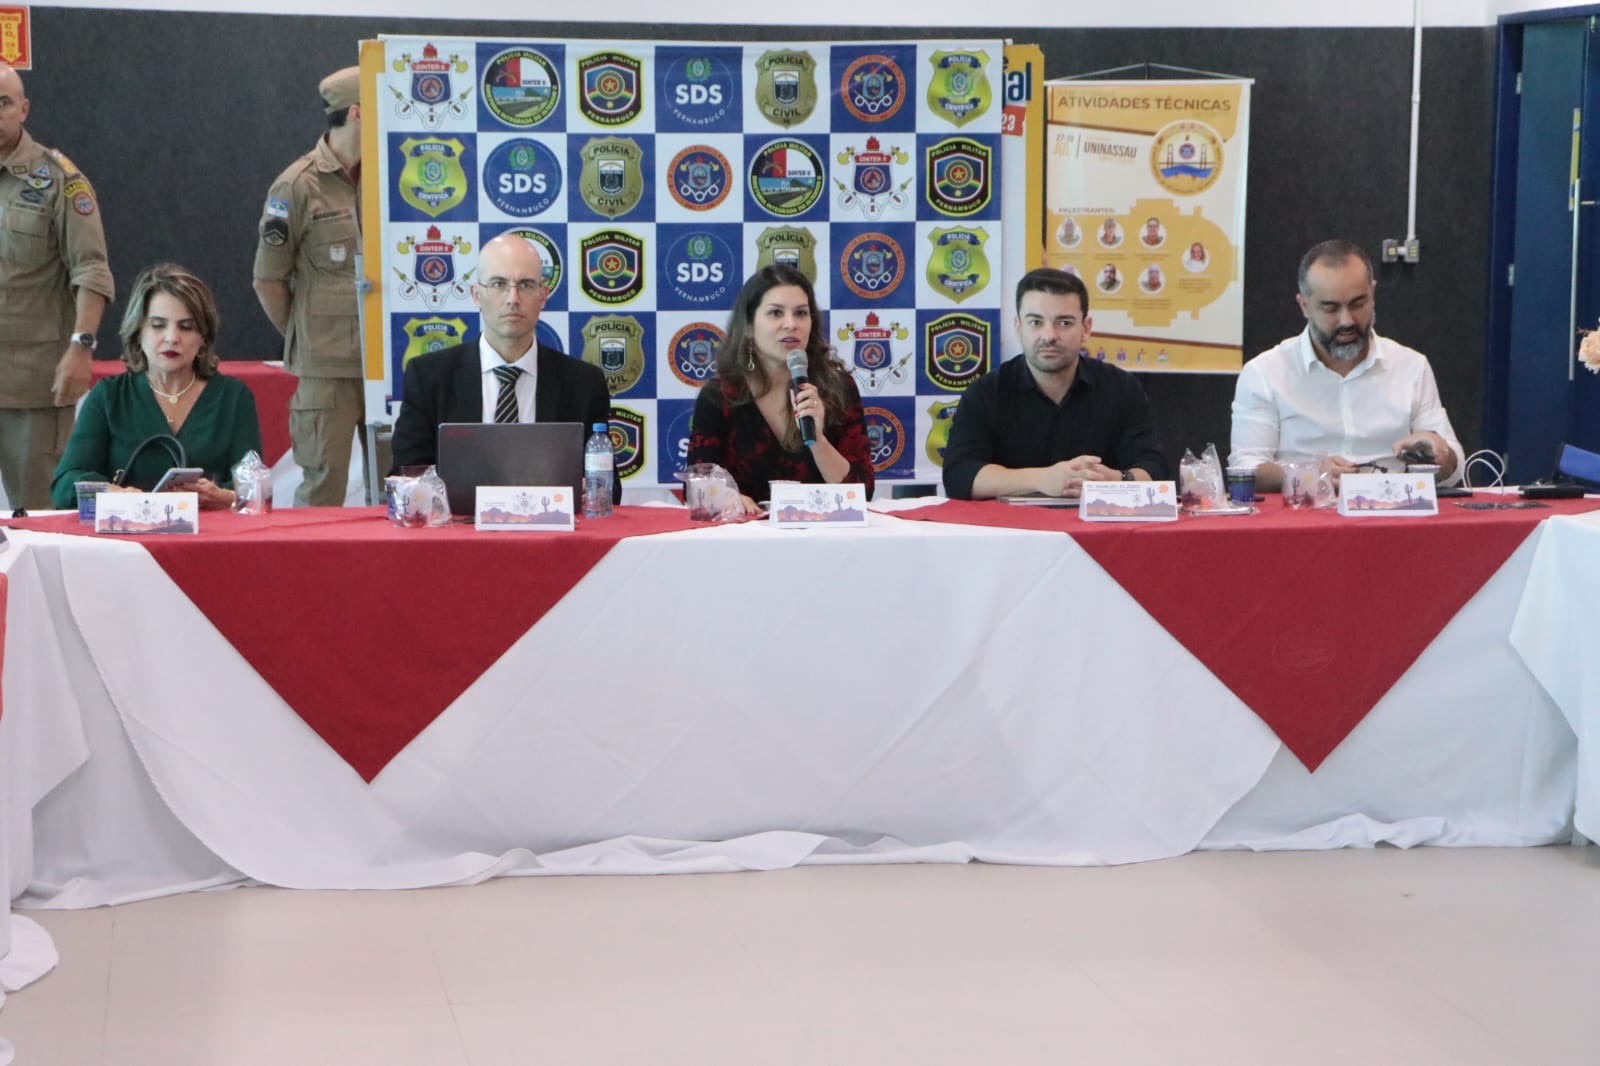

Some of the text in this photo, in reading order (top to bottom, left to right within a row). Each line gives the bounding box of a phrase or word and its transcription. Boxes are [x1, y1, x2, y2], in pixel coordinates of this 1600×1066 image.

[612, 55, 638, 68] MILITAR
[768, 55, 804, 66] POLÍCIA
[676, 84, 722, 105] SDS
[1058, 95, 1232, 112] ATIVIDADES TÉCNICAS
[586, 110, 634, 124] PERNAMBUCO
[672, 108, 726, 126] PERNAMBUCO
[772, 108, 800, 116] CIVIL
[594, 144, 630, 155] POLÍCIA
[961, 144, 986, 156] MILITAR
[1084, 141, 1137, 158] UNINASSAU
[499, 173, 546, 194] SDS
[496, 198, 550, 214] PERNAMBUCO
[598, 197, 626, 206] CIVIL
[936, 198, 982, 212] PERNAMBUCO
[526, 232, 550, 246] MILITAR
[614, 234, 640, 247] MILITAR
[769, 232, 804, 244] POLÍCIA
[676, 262, 724, 282] SDS
[588, 289, 636, 302] PERNAMBUCO
[674, 286, 726, 302] PERNAMBUCO
[595, 323, 630, 334] POLÍCIA
[960, 320, 986, 332] MILITAR
[616, 410, 642, 422] MILITAR
